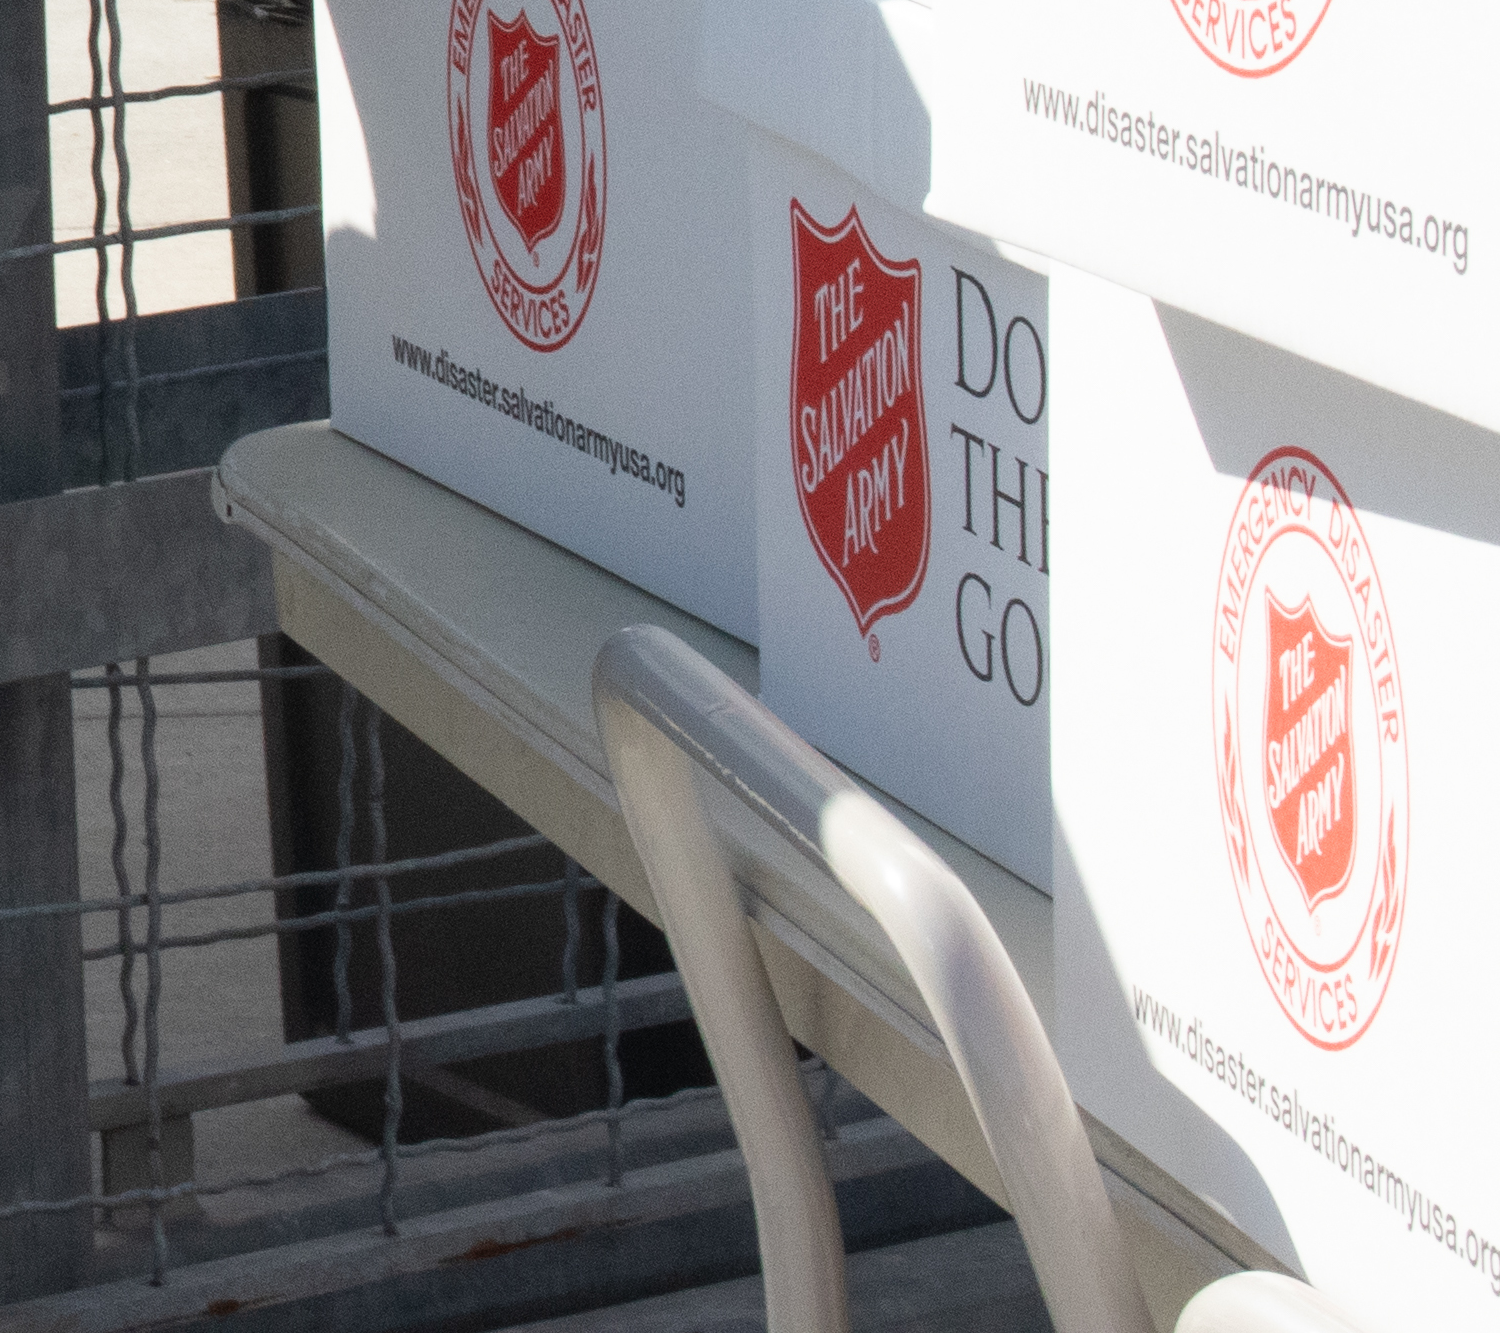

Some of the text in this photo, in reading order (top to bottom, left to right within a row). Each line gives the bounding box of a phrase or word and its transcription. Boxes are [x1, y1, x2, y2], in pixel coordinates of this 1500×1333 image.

[500, 38, 530, 103] THE
[516, 124, 554, 217] ARMY
[1022, 76, 1469, 275] www.disaster.salvationarmyusa.org
[490, 258, 570, 339] SERVICES
[814, 257, 864, 363] THE
[391, 333, 686, 509] www.disaster.salvationarmyusa.org
[801, 300, 911, 493] SALVATION
[841, 416, 910, 568] ARMY
[1219, 465, 1400, 745] EMERGENCY DISASTER
[1279, 631, 1316, 711] THE
[1267, 663, 1347, 809] SALVATION
[1296, 751, 1345, 865] ARMY
[1260, 915, 1358, 1033] SERVICES
[1132, 983, 1500, 1298] www.disaster.salvationarmyusa.org
